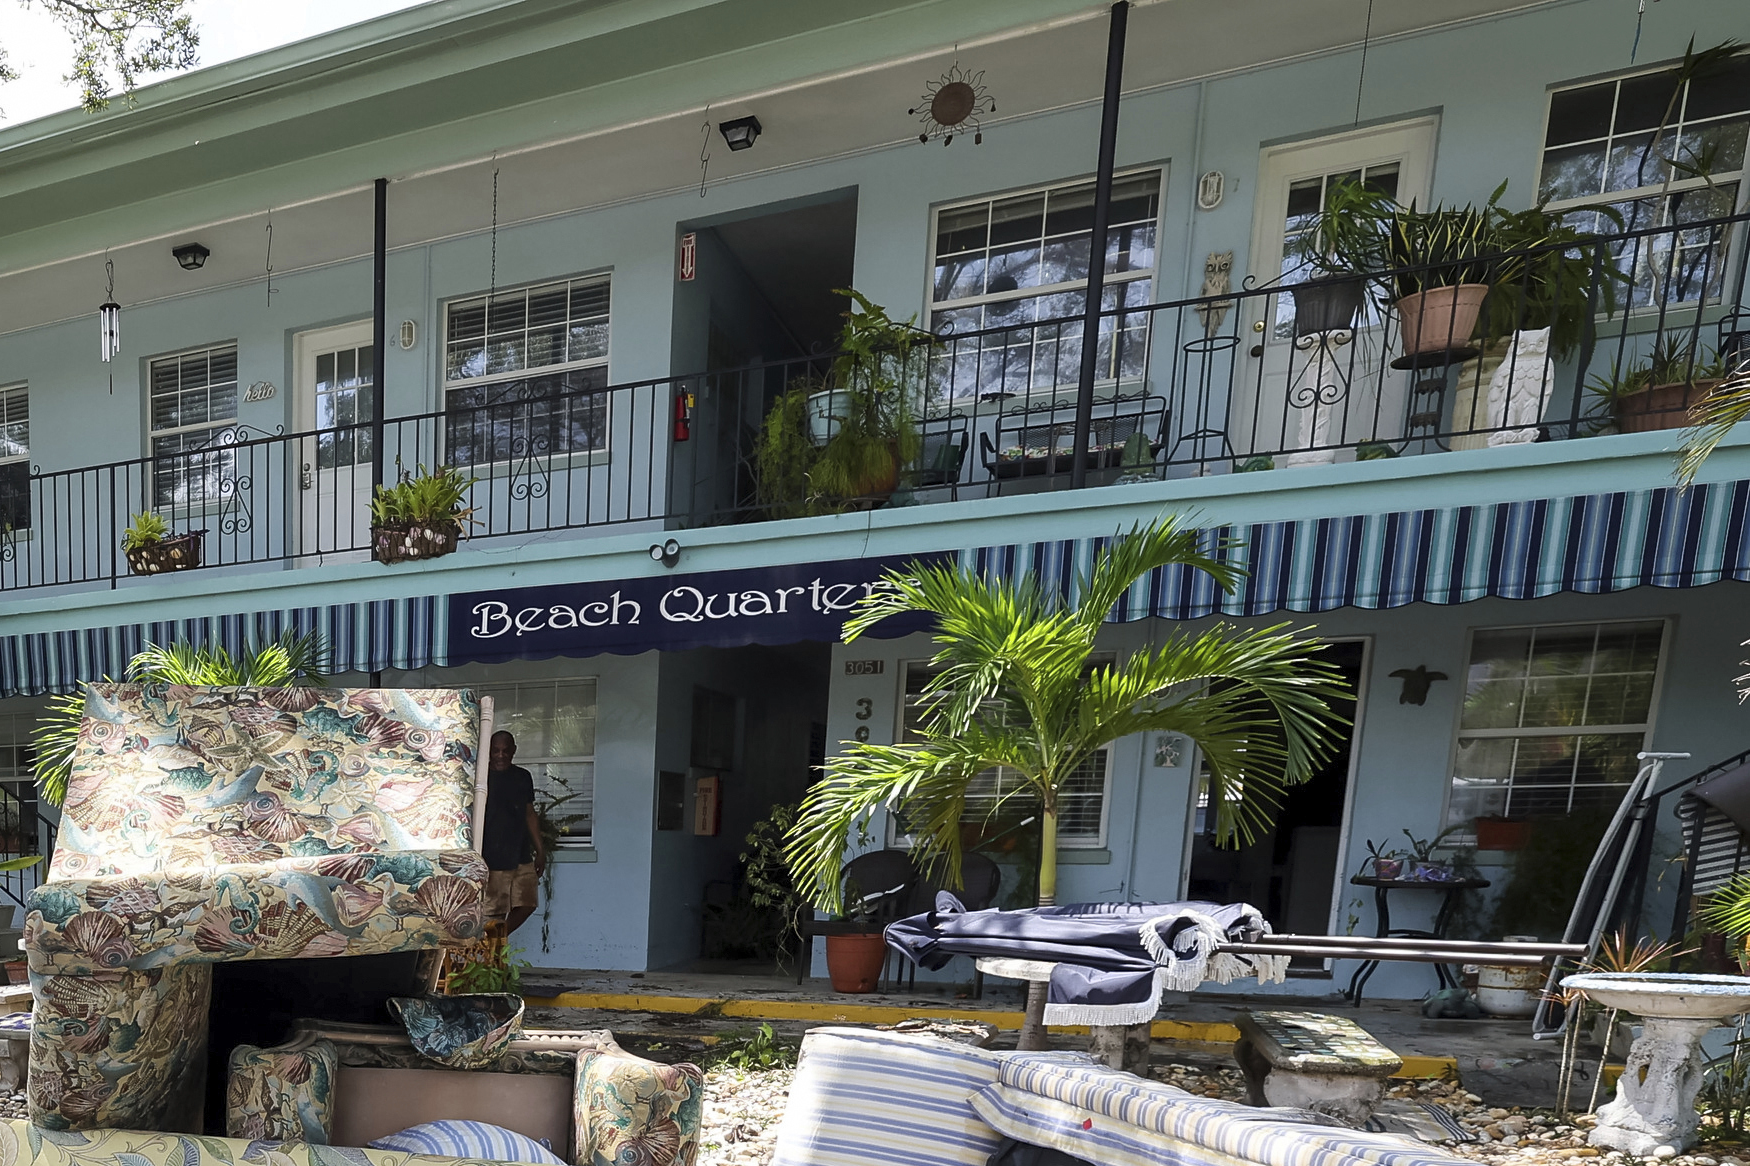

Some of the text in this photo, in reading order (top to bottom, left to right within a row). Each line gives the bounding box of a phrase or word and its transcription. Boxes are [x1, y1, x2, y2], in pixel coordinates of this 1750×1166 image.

[1232, 178, 1240, 192] 7
[390, 334, 396, 346] 6
[243, 382, 275, 402] hello
[470, 591, 641, 639] Beach
[846, 661, 882, 674] 3051
